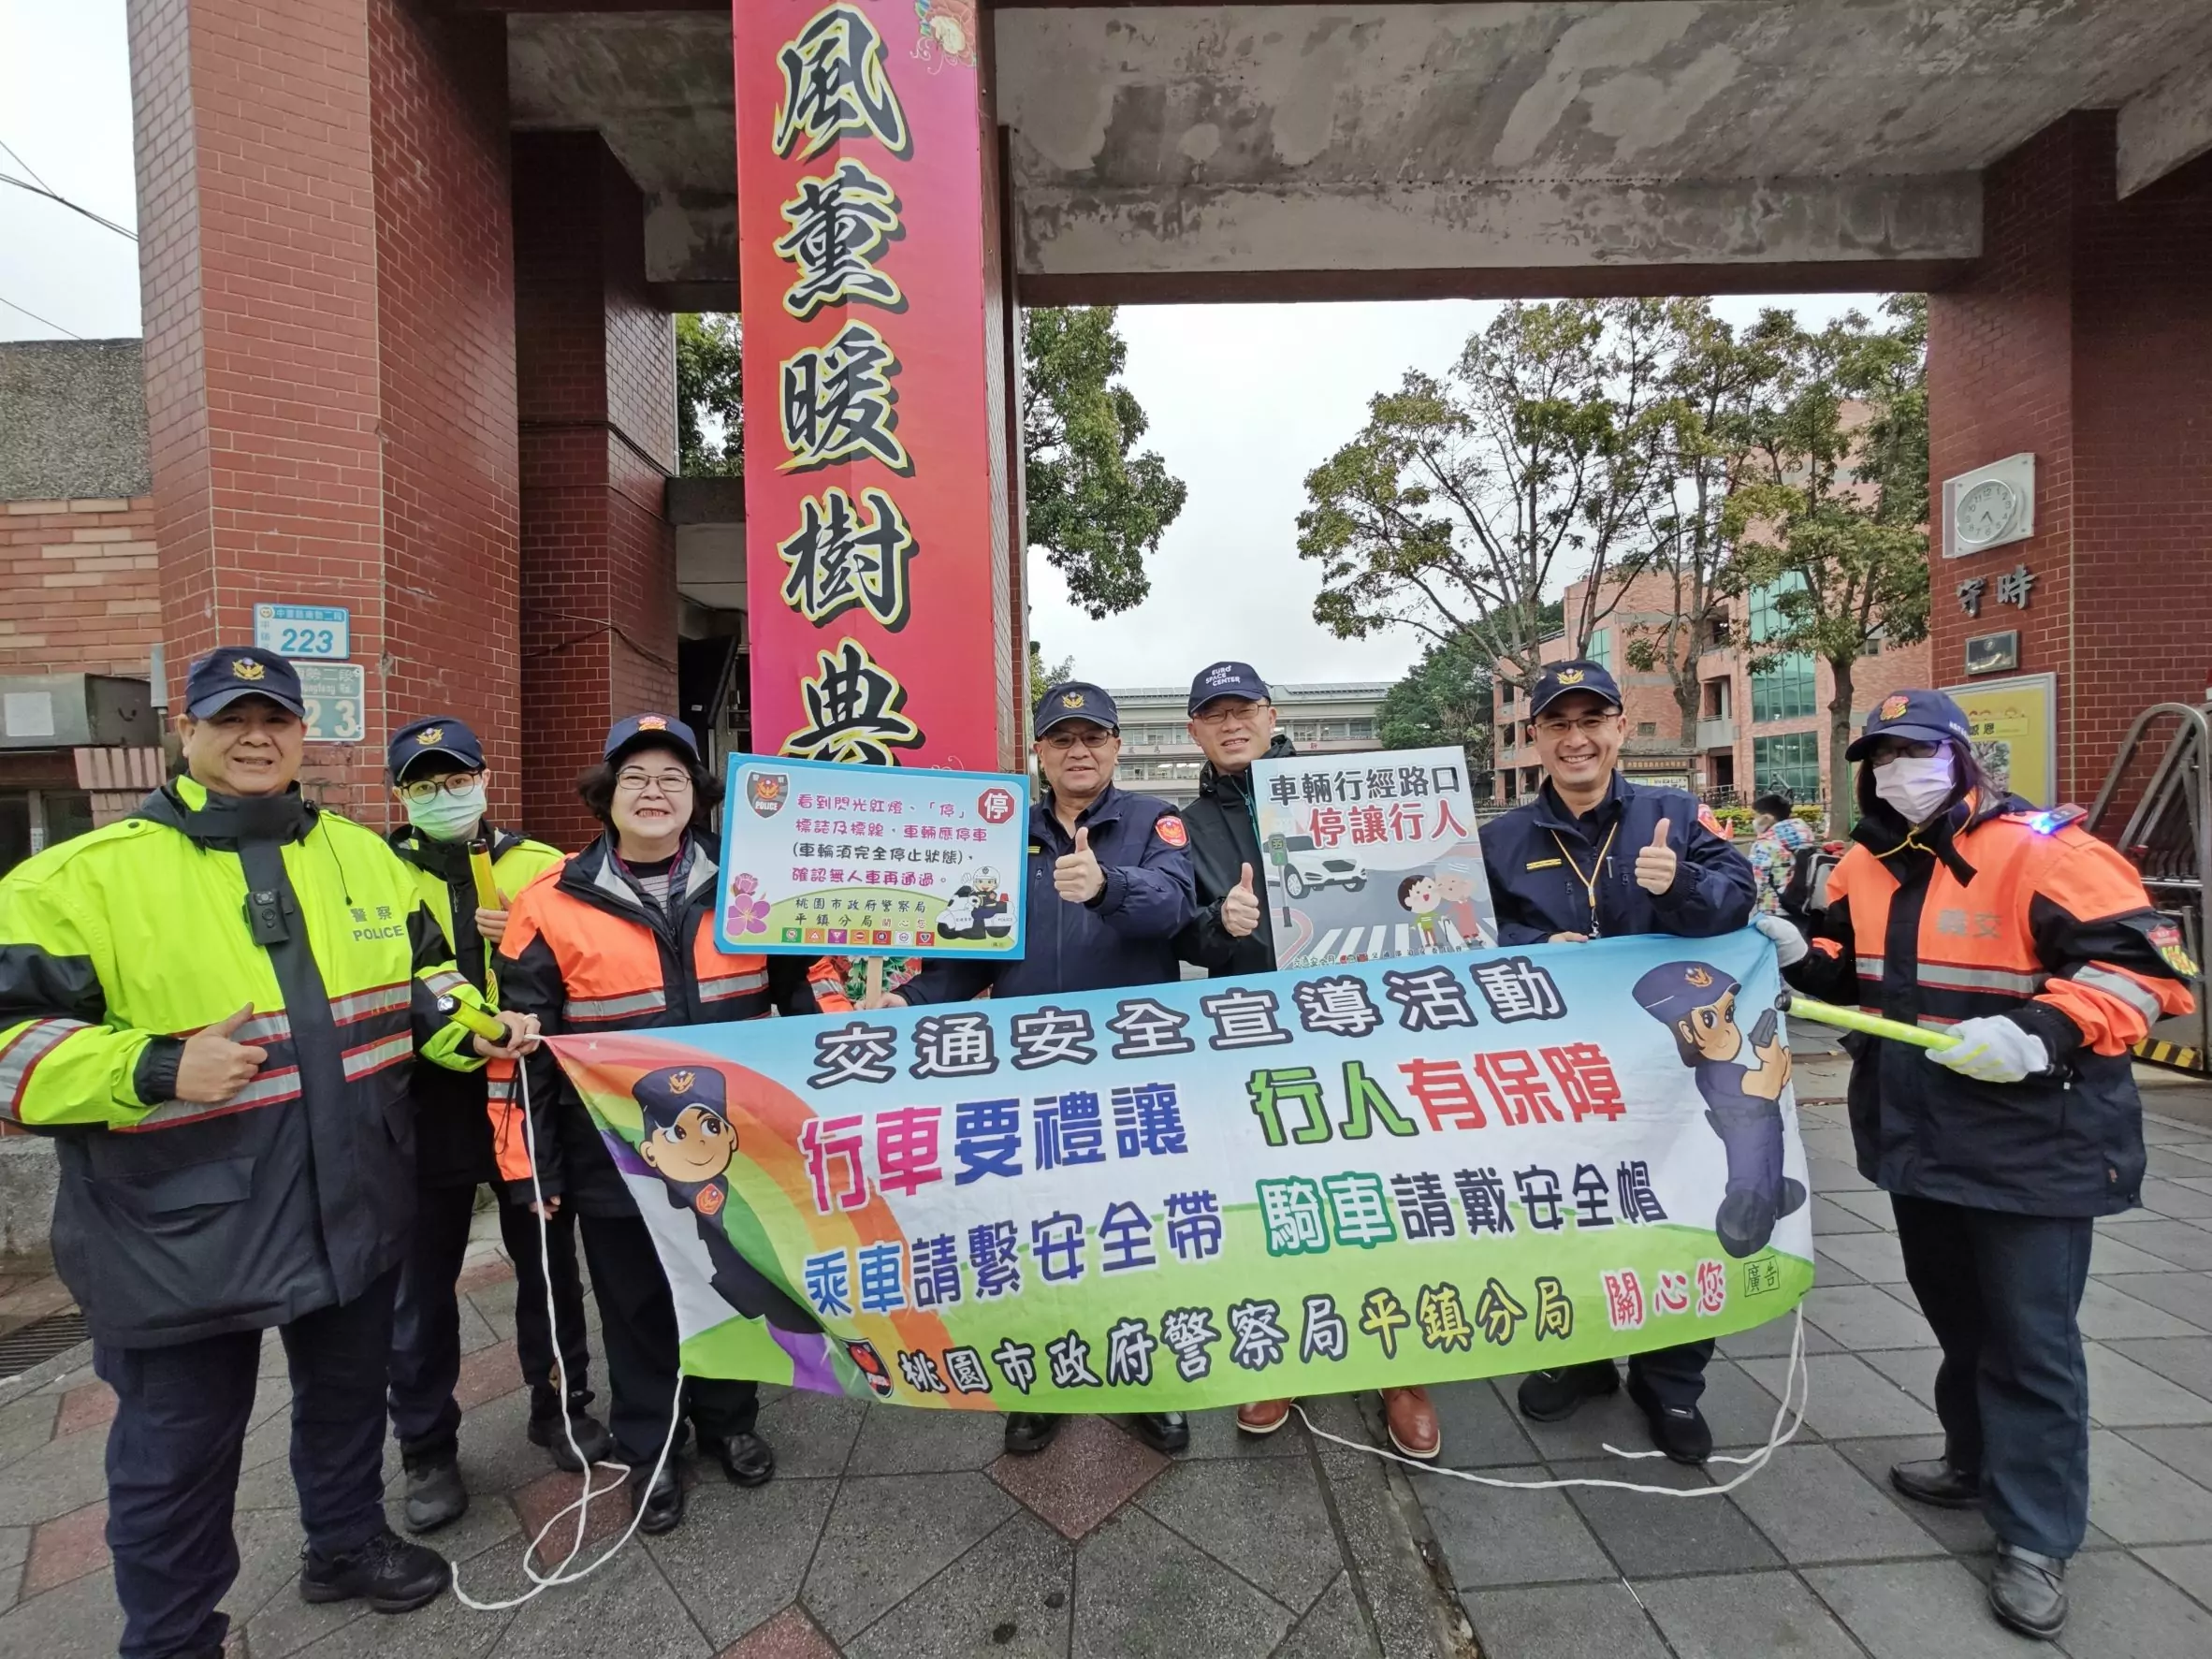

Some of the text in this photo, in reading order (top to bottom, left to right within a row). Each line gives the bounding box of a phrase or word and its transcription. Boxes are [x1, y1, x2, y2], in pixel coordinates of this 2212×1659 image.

[1956, 563, 2036, 618] 守時
[281, 628, 334, 653] 223
[1205, 672, 1227, 684] SPACE
[1211, 665, 1232, 676] EURO
[1212, 676, 1241, 687] CENTER
[1268, 765, 1461, 807] 車輛行經路口
[755, 801, 779, 810] POLICE
[983, 793, 1009, 820] 停
[1309, 798, 1468, 848] 停讓行人
[795, 897, 926, 913] 桃園市政府警察局
[353, 925, 404, 941] POLICE
[808, 954, 1567, 1089] 交通安全宣導活動
[801, 1041, 1627, 1214] 行車要禮讓 行人有保障
[802, 1159, 1668, 1317] 乘車請繫安全帶 騎車請戴安全帽
[1747, 1260, 1777, 1292] 廣告
[1601, 1259, 1727, 1329] 關心您
